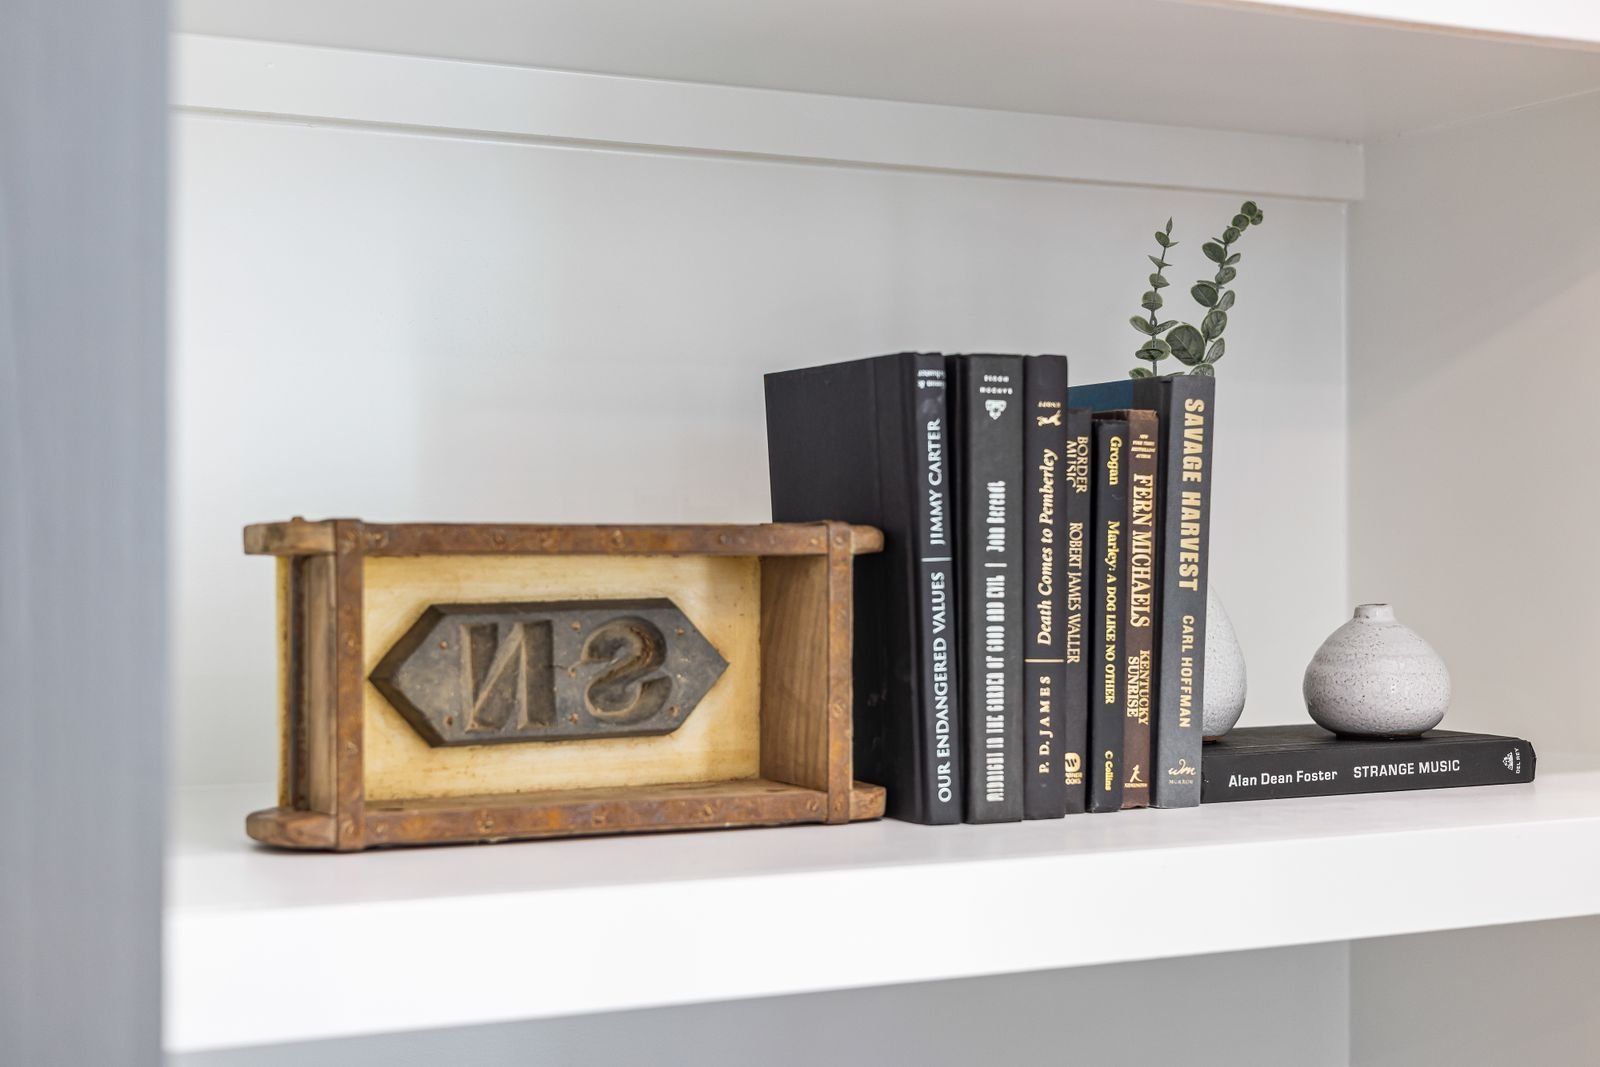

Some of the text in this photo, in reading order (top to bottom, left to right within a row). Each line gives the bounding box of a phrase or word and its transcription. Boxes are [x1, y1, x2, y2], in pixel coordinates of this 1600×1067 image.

[927, 418, 946, 545] JIMMY CARTER
[1066, 441, 1077, 488] MUSIC
[1076, 436, 1088, 493] BORDER
[1107, 436, 1123, 486] Grogan
[1132, 473, 1154, 527] FERN
[1178, 398, 1205, 591] SAVAGE HARVEST
[1037, 448, 1058, 645] Death Comes to Pemberley
[1067, 522, 1083, 664] ROBERT JAMES WALLER
[1106, 574, 1117, 583] A
[1106, 586, 1117, 612] DOG
[1130, 530, 1153, 627] MICHAELS
[1105, 644, 1116, 661] NO
[1106, 614, 1116, 642] LIKE
[931, 571, 952, 802] OUR ENDANGERED VALUES
[1105, 664, 1116, 704] OTHER
[1127, 656, 1139, 718] SUNRISE
[1138, 650, 1150, 726] KENTUCKY
[1179, 615, 1194, 728] CARL HOFFMAN
[1040, 675, 1053, 738] JAMES
[1228, 769, 1338, 788] Alan Dean Foster
[1353, 759, 1461, 779] STRANGE MUSIC
